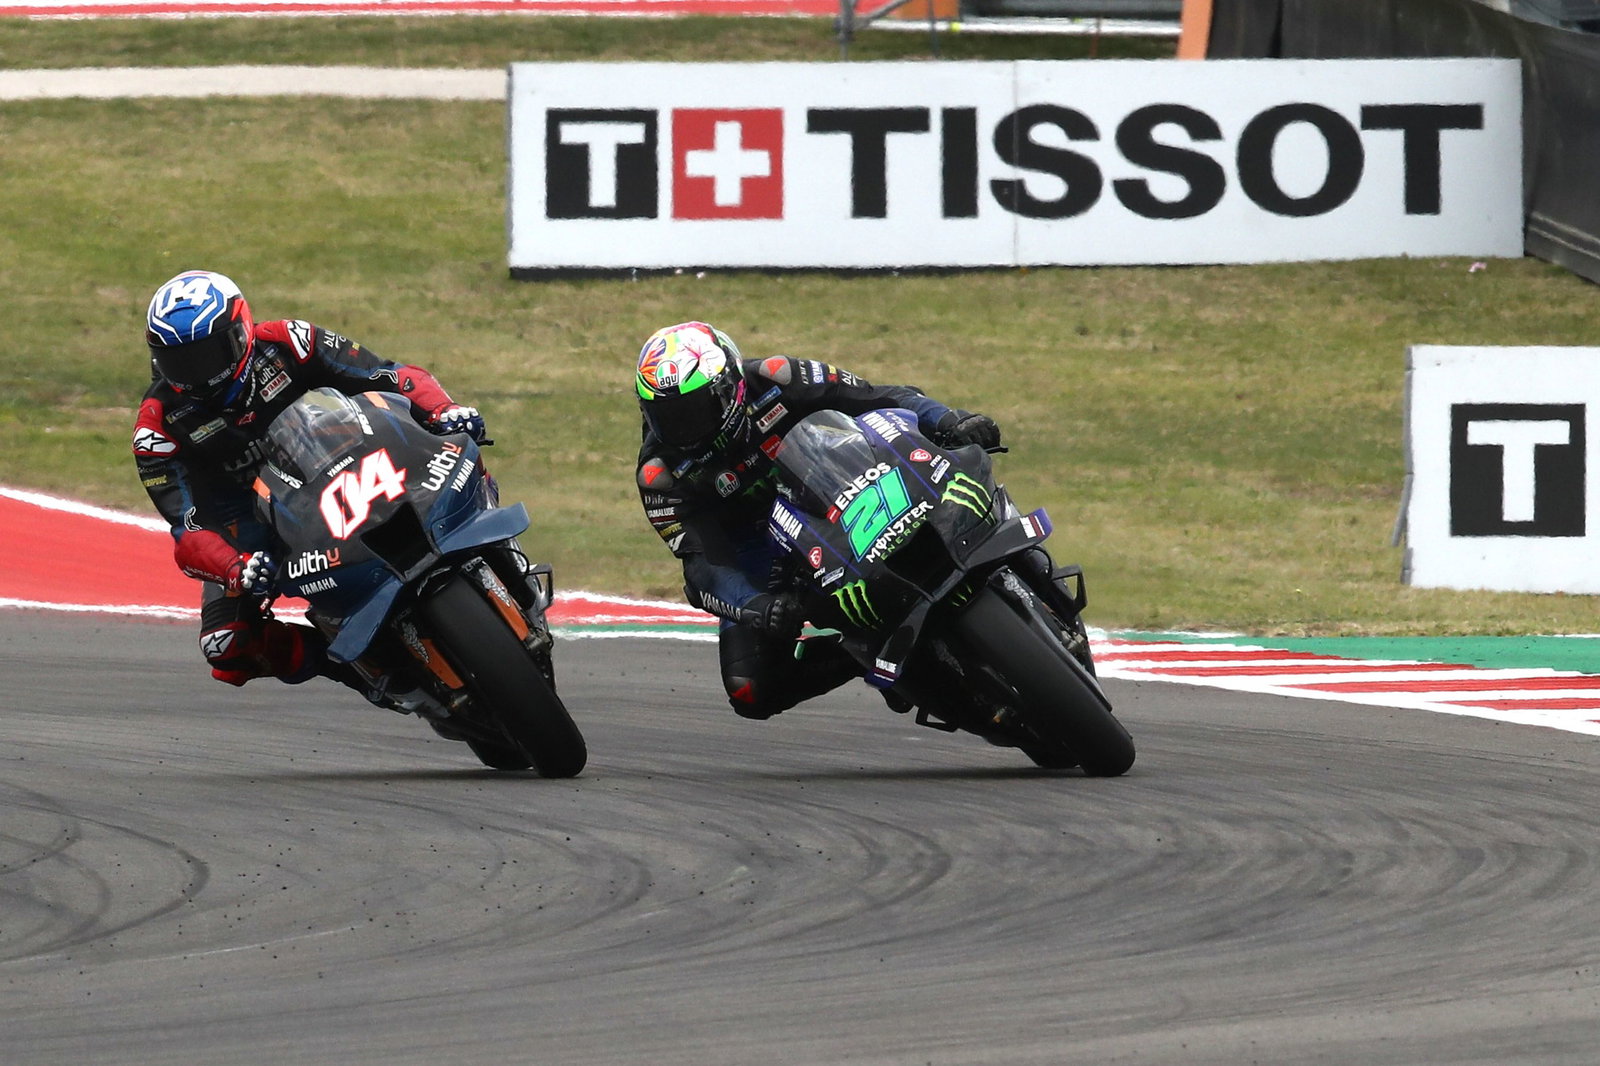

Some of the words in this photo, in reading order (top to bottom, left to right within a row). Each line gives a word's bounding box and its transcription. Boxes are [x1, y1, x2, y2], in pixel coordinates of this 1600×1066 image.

[807, 102, 1483, 219] TISSOT
[267, 373, 288, 392] YAMAHA
[764, 405, 784, 424] YAMAHA
[862, 412, 902, 443] YAMAHA
[327, 456, 355, 478] YAMAHA
[451, 458, 475, 493] YAMAHA
[835, 462, 891, 511] ENEOS
[319, 447, 406, 540] 04
[772, 501, 803, 540] YAMAHA
[840, 466, 912, 563] 21
[866, 501, 934, 563] MONSTER
[881, 515, 927, 560] ENERGY
[300, 576, 338, 596] YAMAHA
